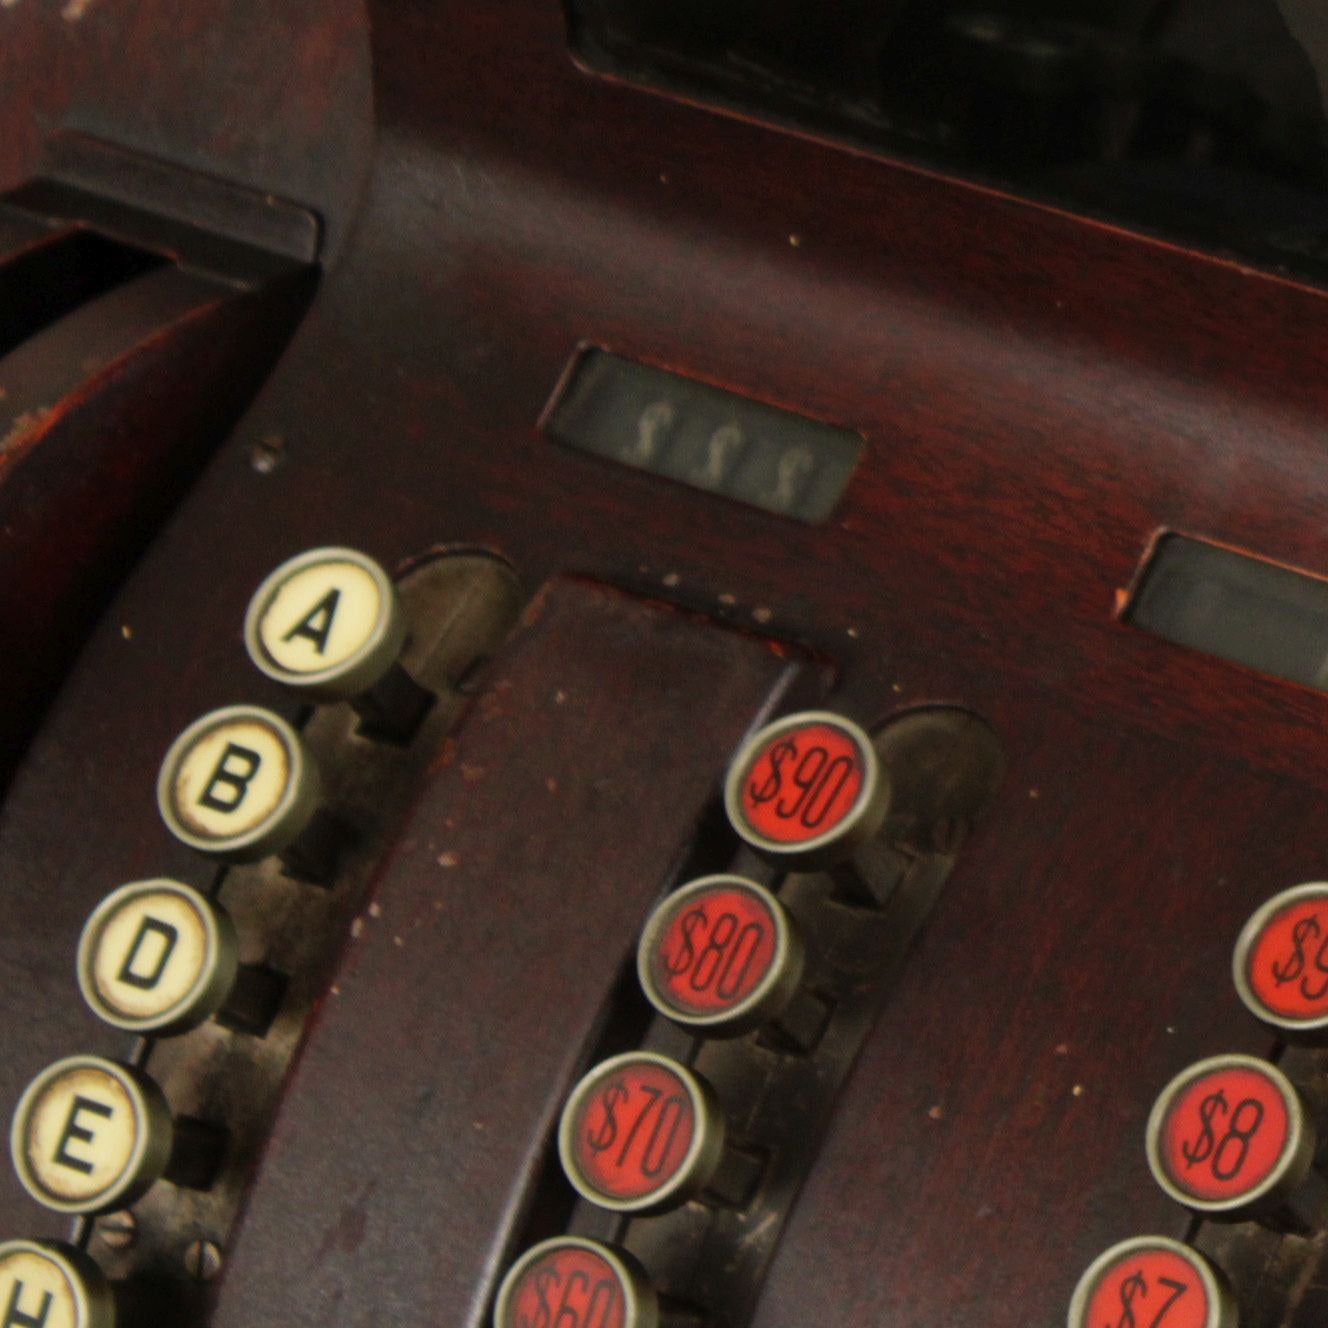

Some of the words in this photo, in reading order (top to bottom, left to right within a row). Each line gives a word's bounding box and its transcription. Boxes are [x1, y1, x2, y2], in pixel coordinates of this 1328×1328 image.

[281, 587, 343, 656] A
[198, 743, 262, 814] B
[750, 738, 854, 829] $90
[117, 915, 179, 991] D
[666, 908, 766, 1002] $80
[51, 1094, 113, 1175] E
[586, 1080, 682, 1178] $70
[1181, 1089, 1264, 1182] $8
